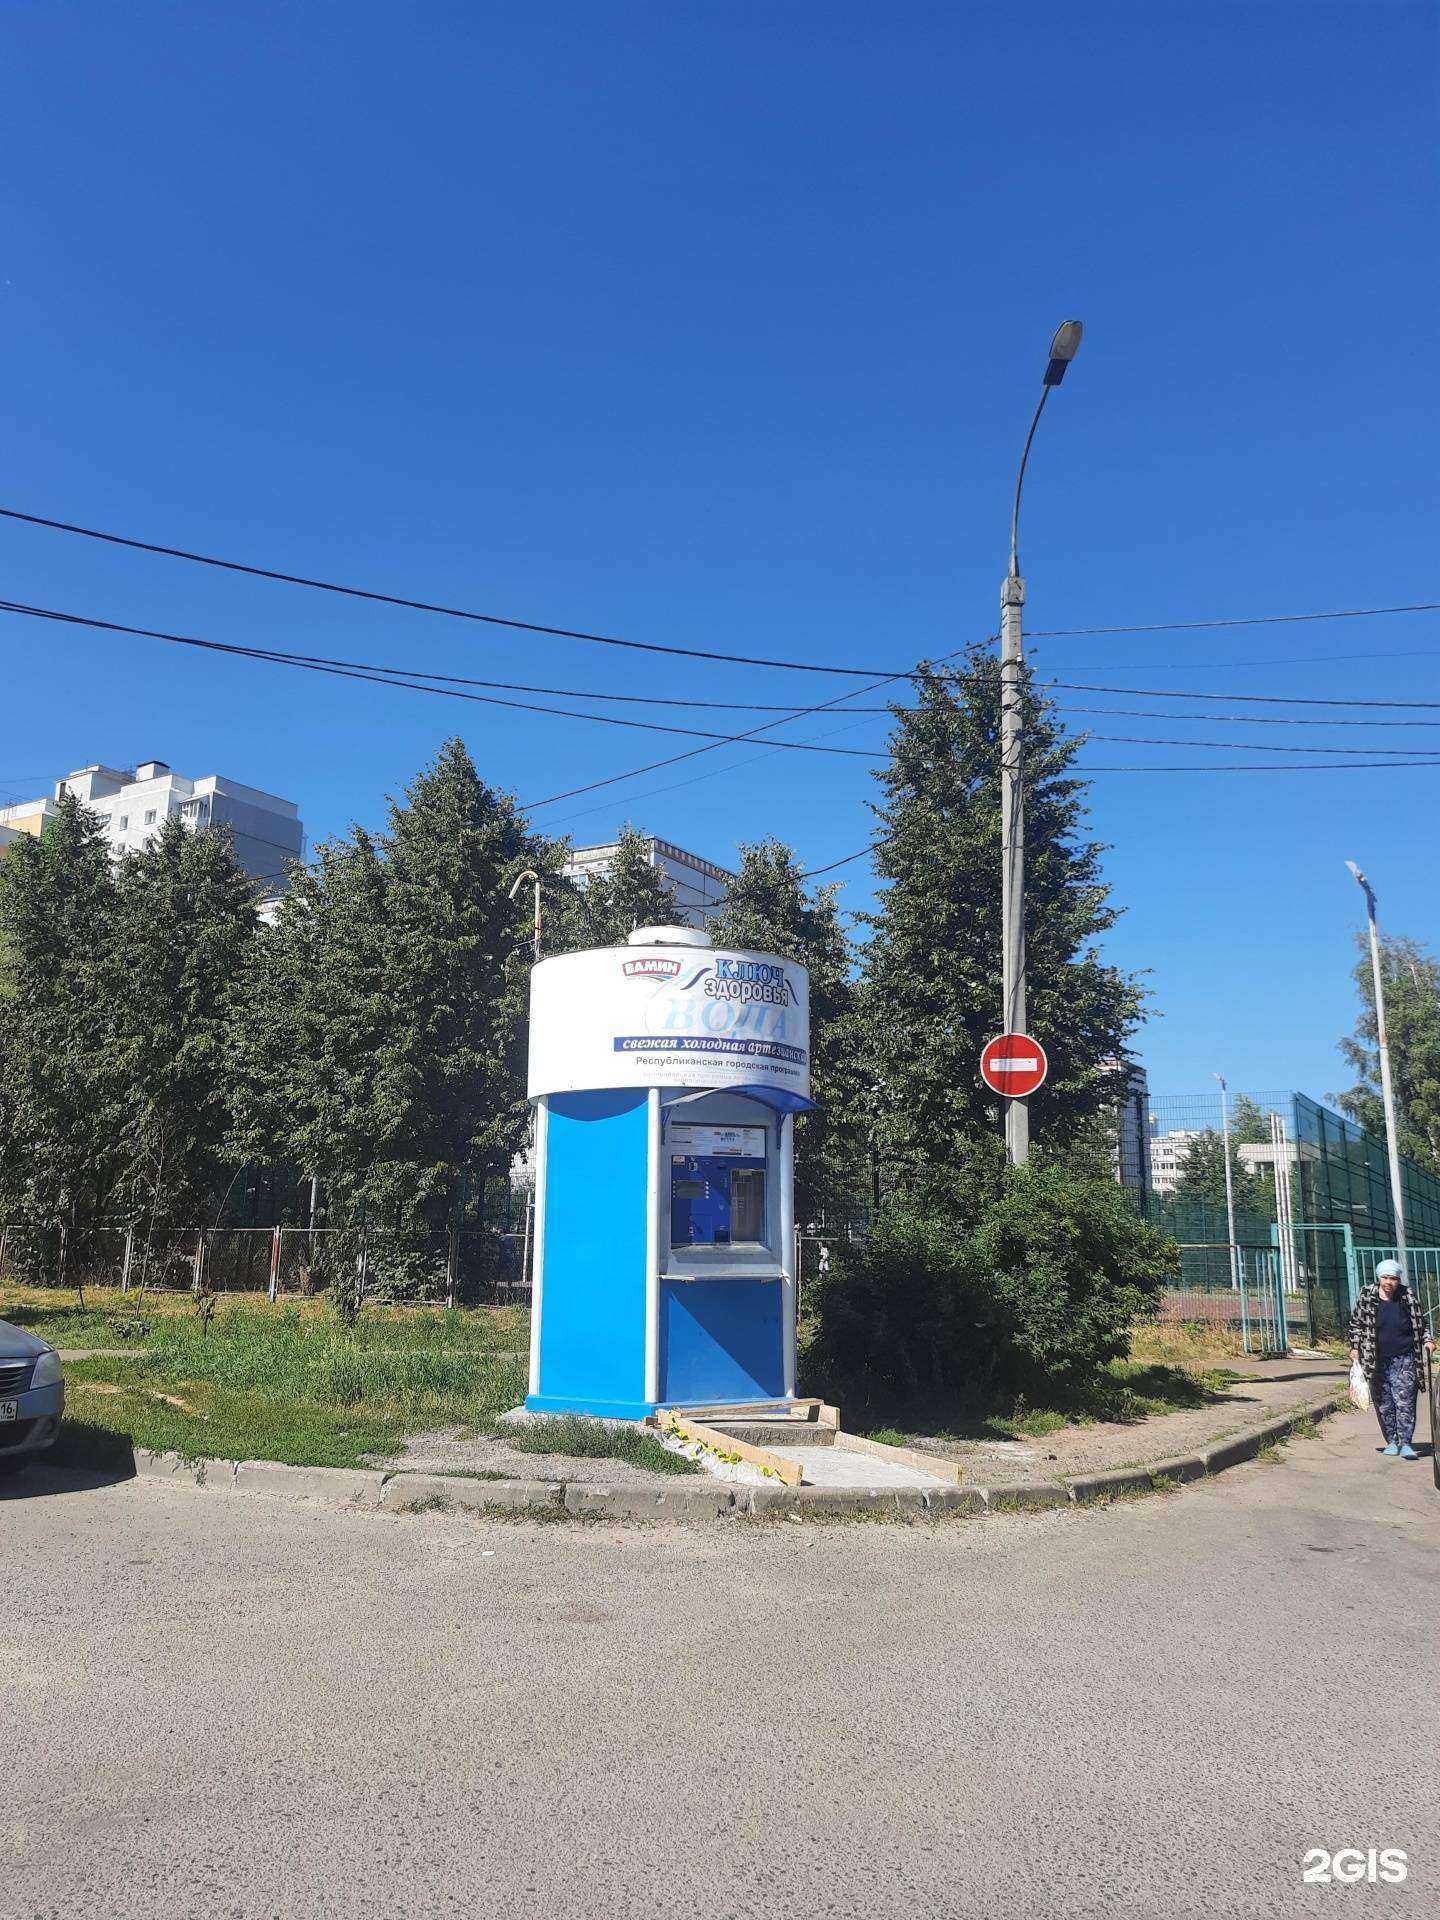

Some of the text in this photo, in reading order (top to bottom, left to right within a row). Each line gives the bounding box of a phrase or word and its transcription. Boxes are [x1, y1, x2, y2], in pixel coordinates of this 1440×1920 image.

[716, 959, 785, 987] КЛЮЧ
[704, 979, 789, 1006] ЗДОРОВЬЯ
[622, 1038, 678, 1050] свежая
[680, 1037, 745, 1052] холодная
[636, 1056, 723, 1067] Республиканская
[725, 1060, 769, 1071] городская
